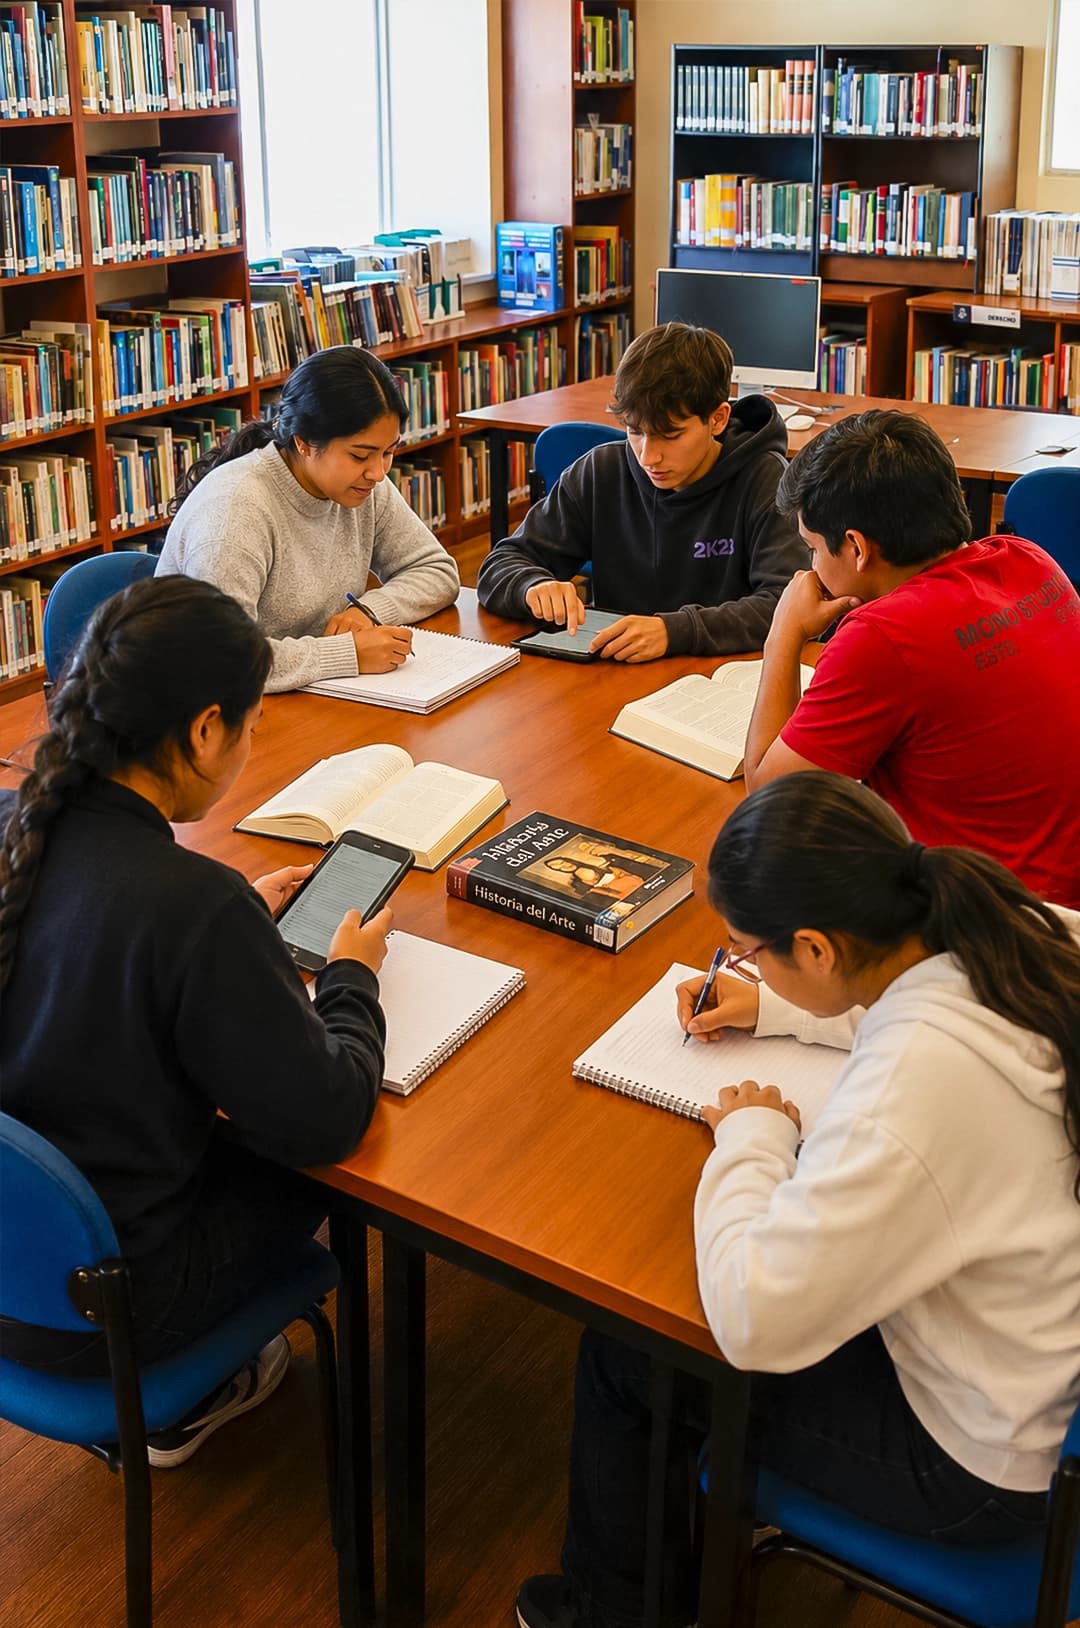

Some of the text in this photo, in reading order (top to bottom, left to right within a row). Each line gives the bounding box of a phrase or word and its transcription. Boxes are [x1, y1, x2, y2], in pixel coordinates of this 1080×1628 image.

[955, 607, 1019, 650] MONO
[475, 884, 523, 912] Historia
[526, 904, 546, 920] del
[548, 912, 576, 931] Arte
